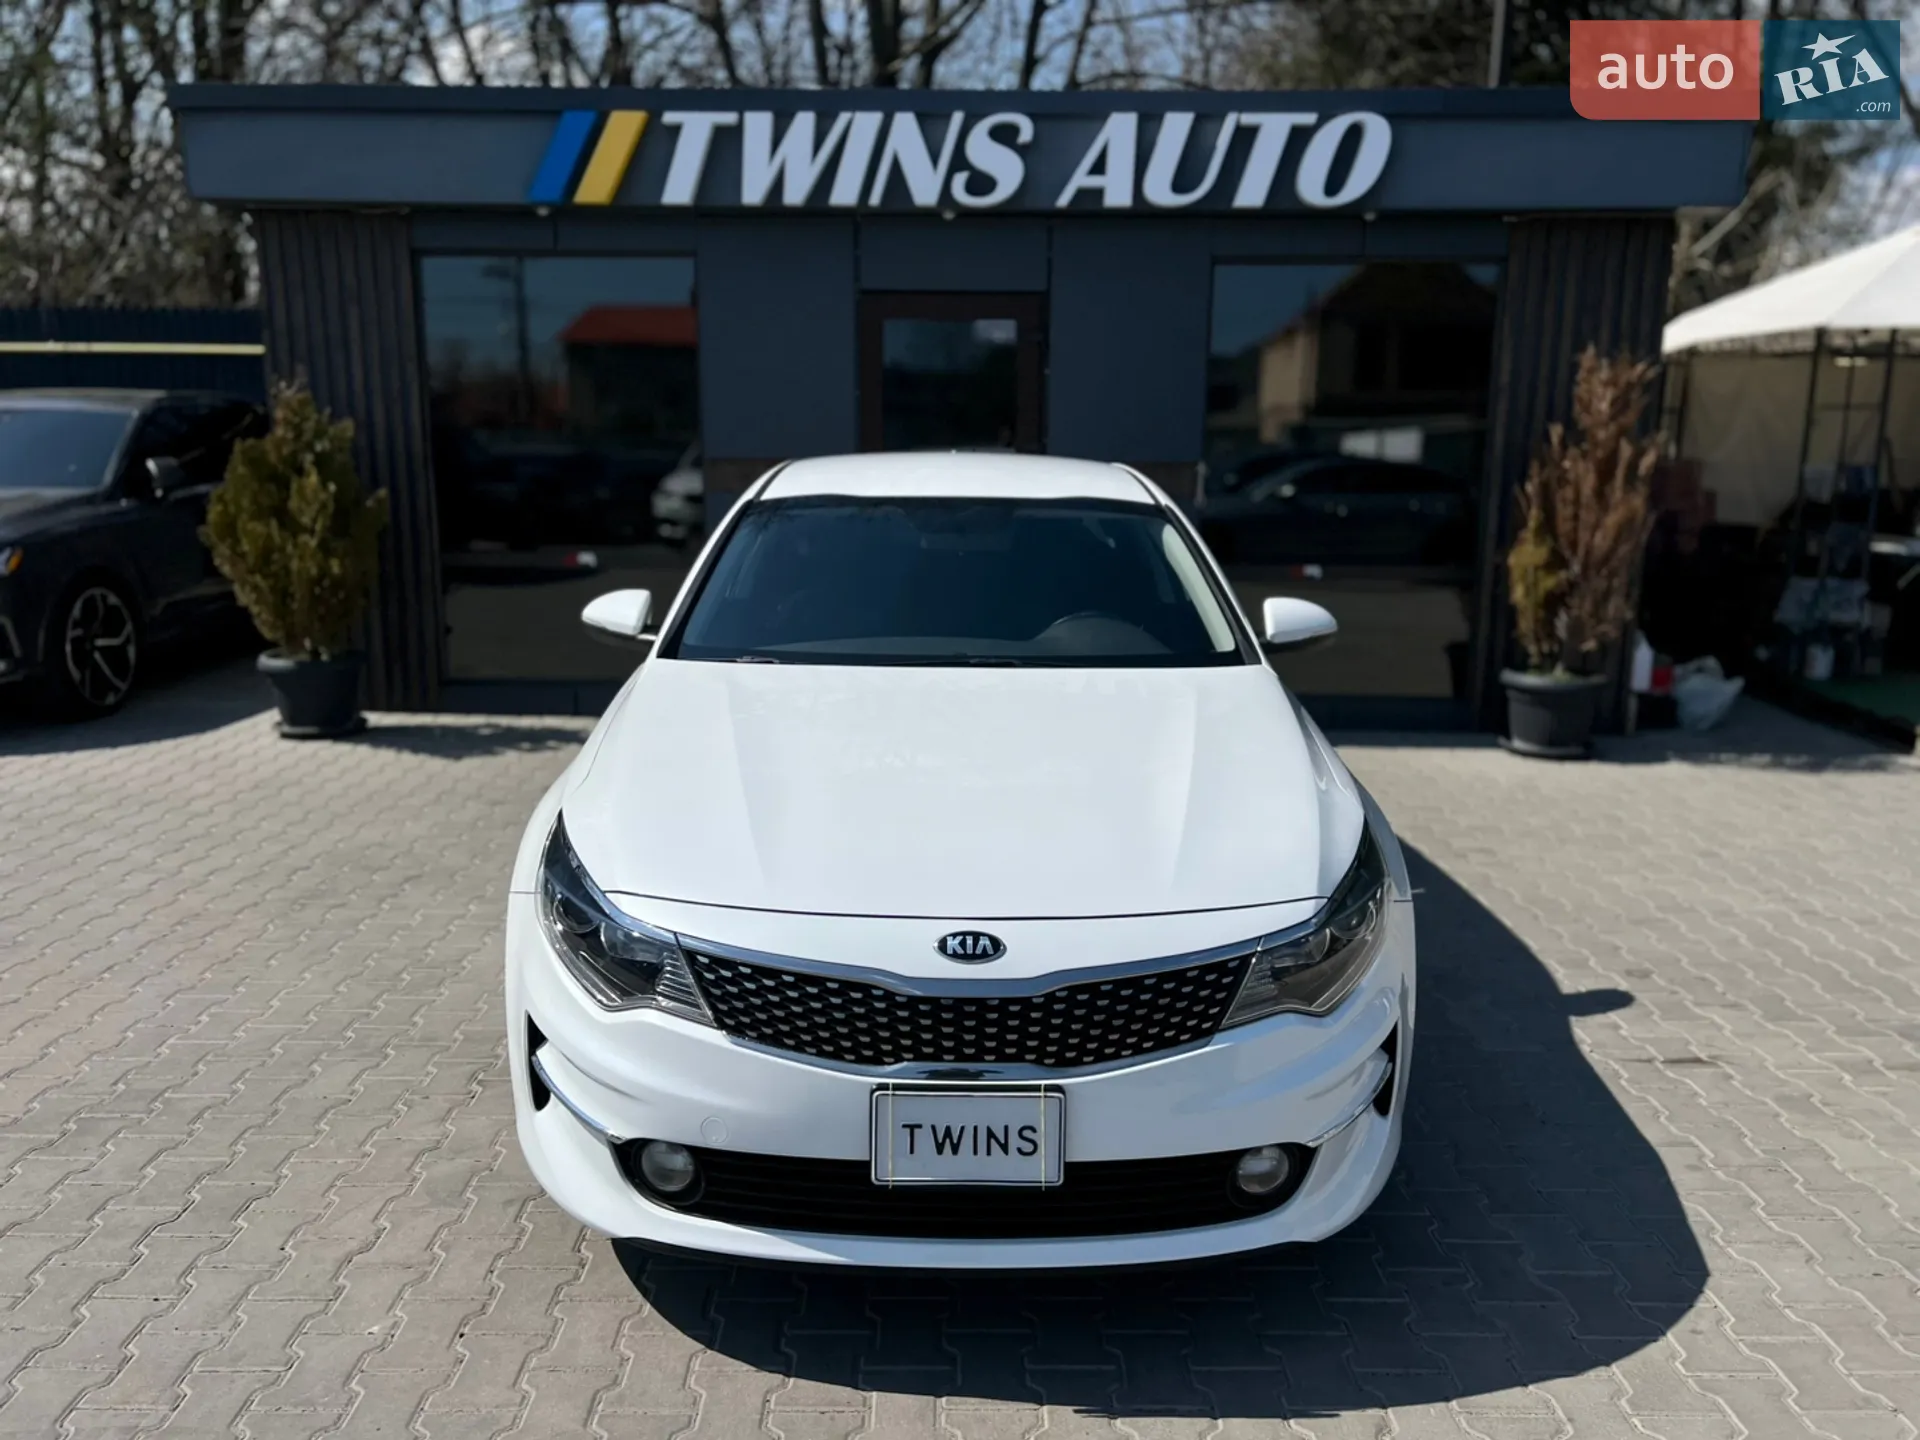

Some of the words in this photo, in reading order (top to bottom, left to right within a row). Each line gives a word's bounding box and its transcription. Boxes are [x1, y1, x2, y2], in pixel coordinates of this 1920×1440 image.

[660, 110, 1035, 208] TWINS
[1054, 110, 1393, 209] AUTO
[946, 935, 995, 955] KIA
[901, 1123, 1039, 1157] TWINS
